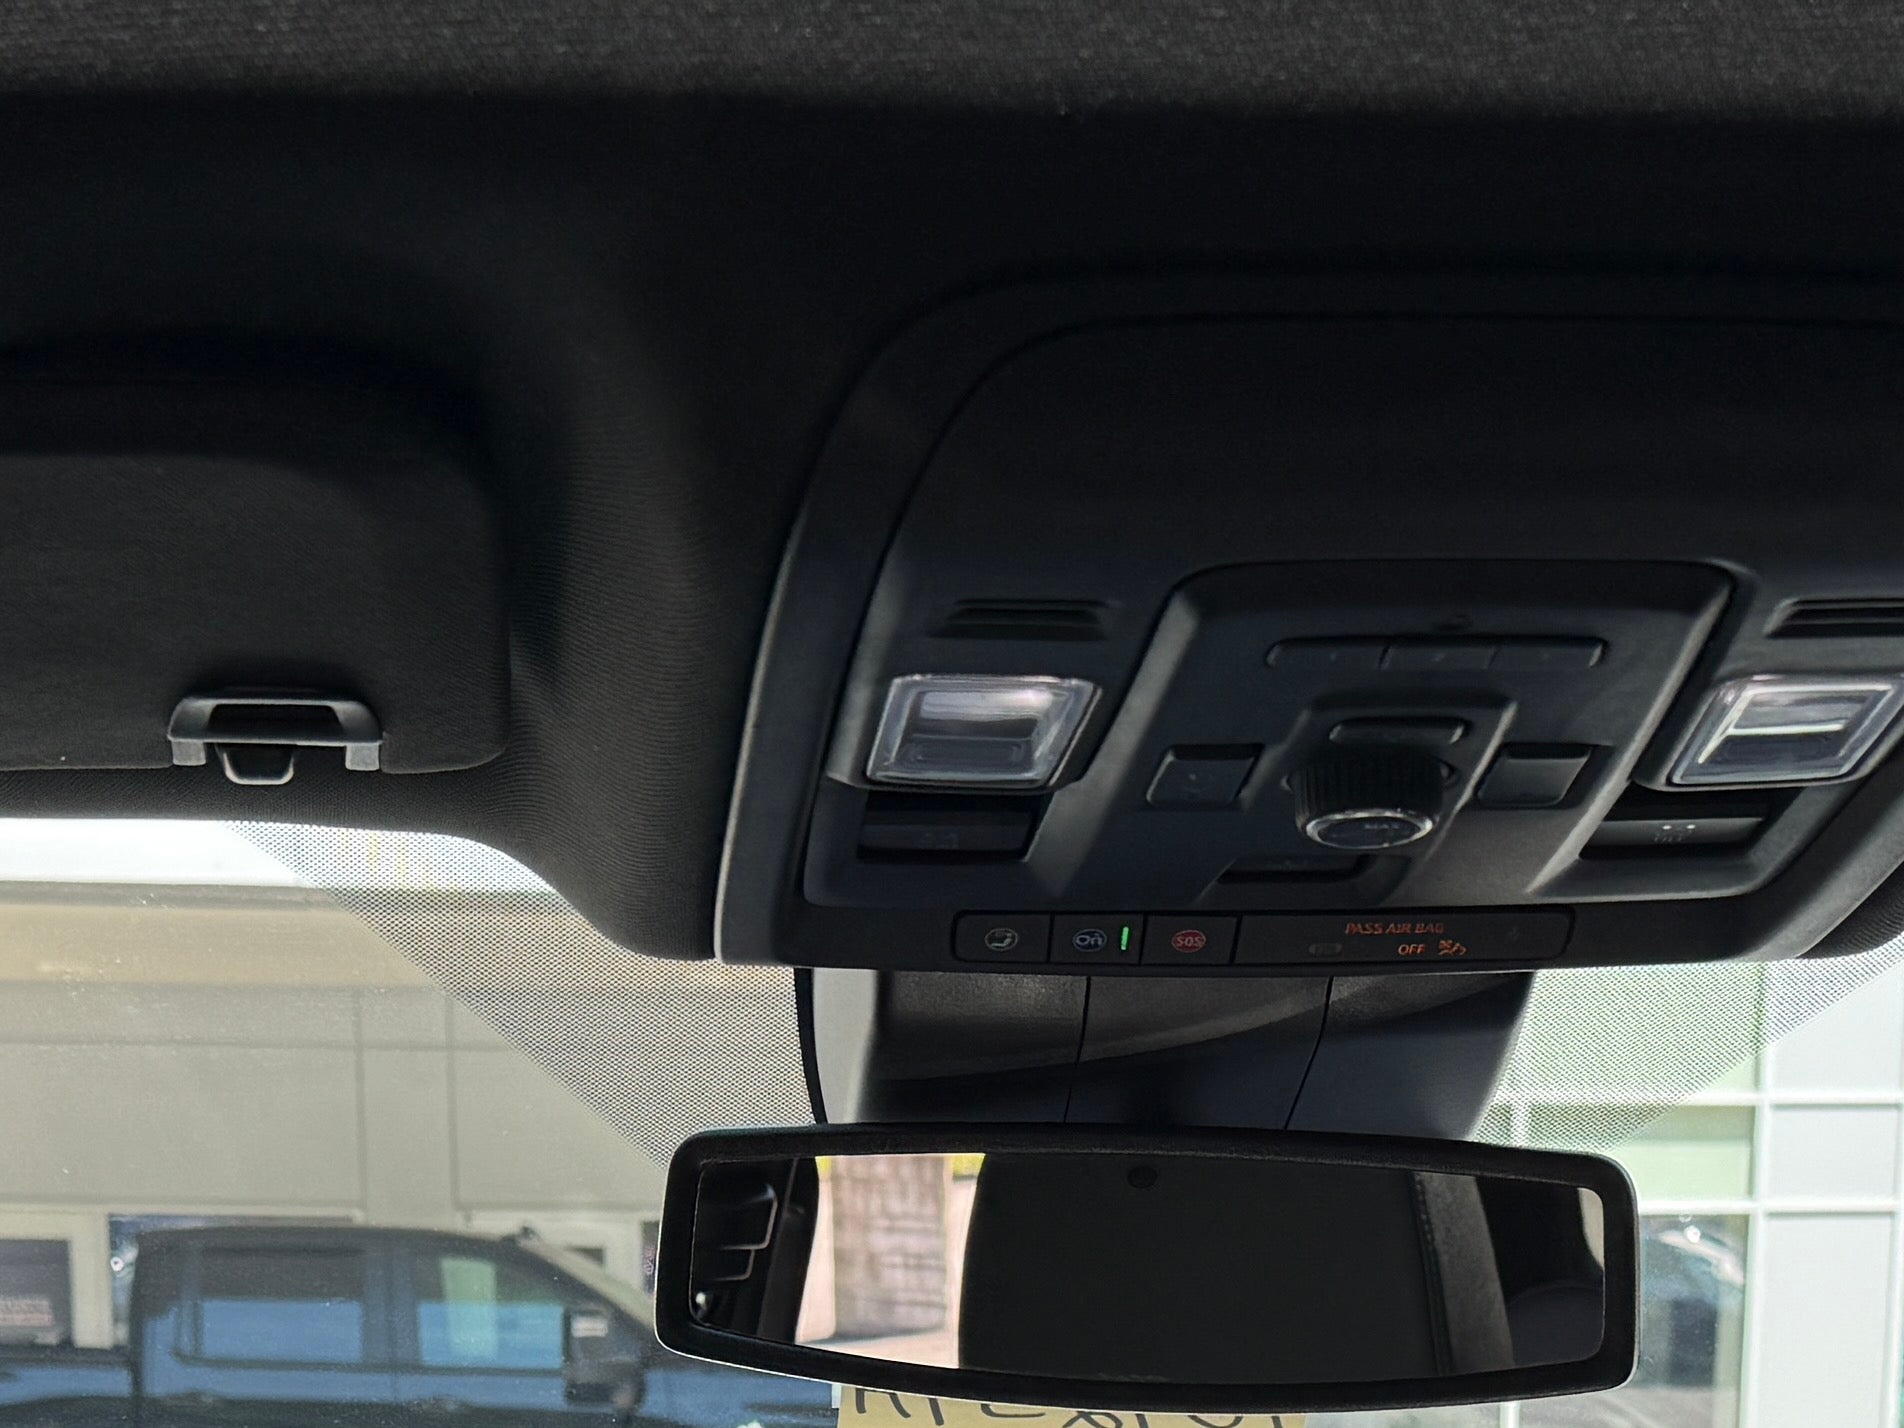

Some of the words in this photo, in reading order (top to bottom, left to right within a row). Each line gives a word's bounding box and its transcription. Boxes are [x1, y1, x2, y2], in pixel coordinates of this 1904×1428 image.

[1345, 923, 1382, 935] PASS
[1385, 922, 1411, 935] AIR
[1415, 923, 1444, 934] BAG
[1175, 935, 1204, 947] SOS
[1397, 943, 1426, 956] OFF
